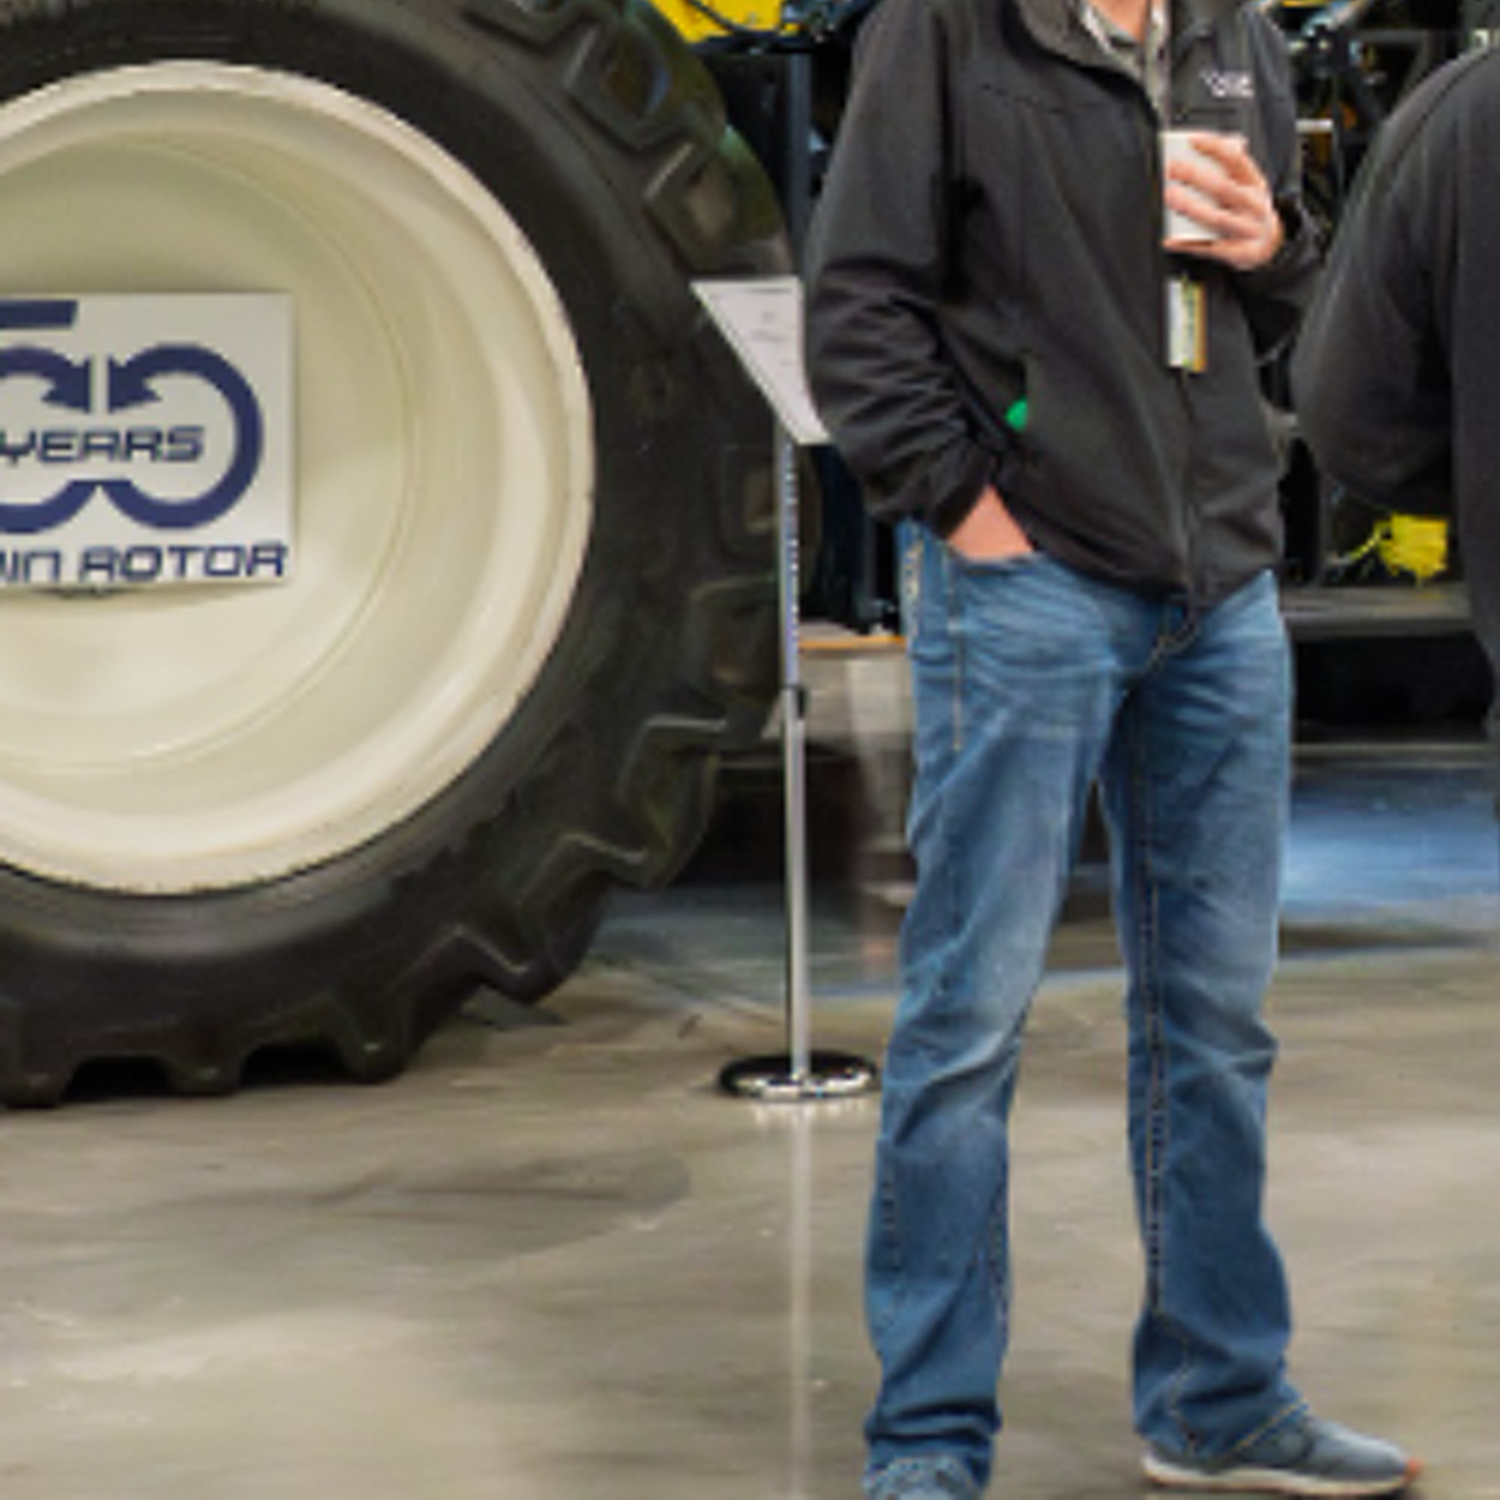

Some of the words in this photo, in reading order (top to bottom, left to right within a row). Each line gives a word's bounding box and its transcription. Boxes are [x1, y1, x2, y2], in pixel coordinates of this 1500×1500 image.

[0, 425, 205, 466] YEARS
[0, 549, 61, 583] IN
[80, 542, 288, 582] ROTOR
